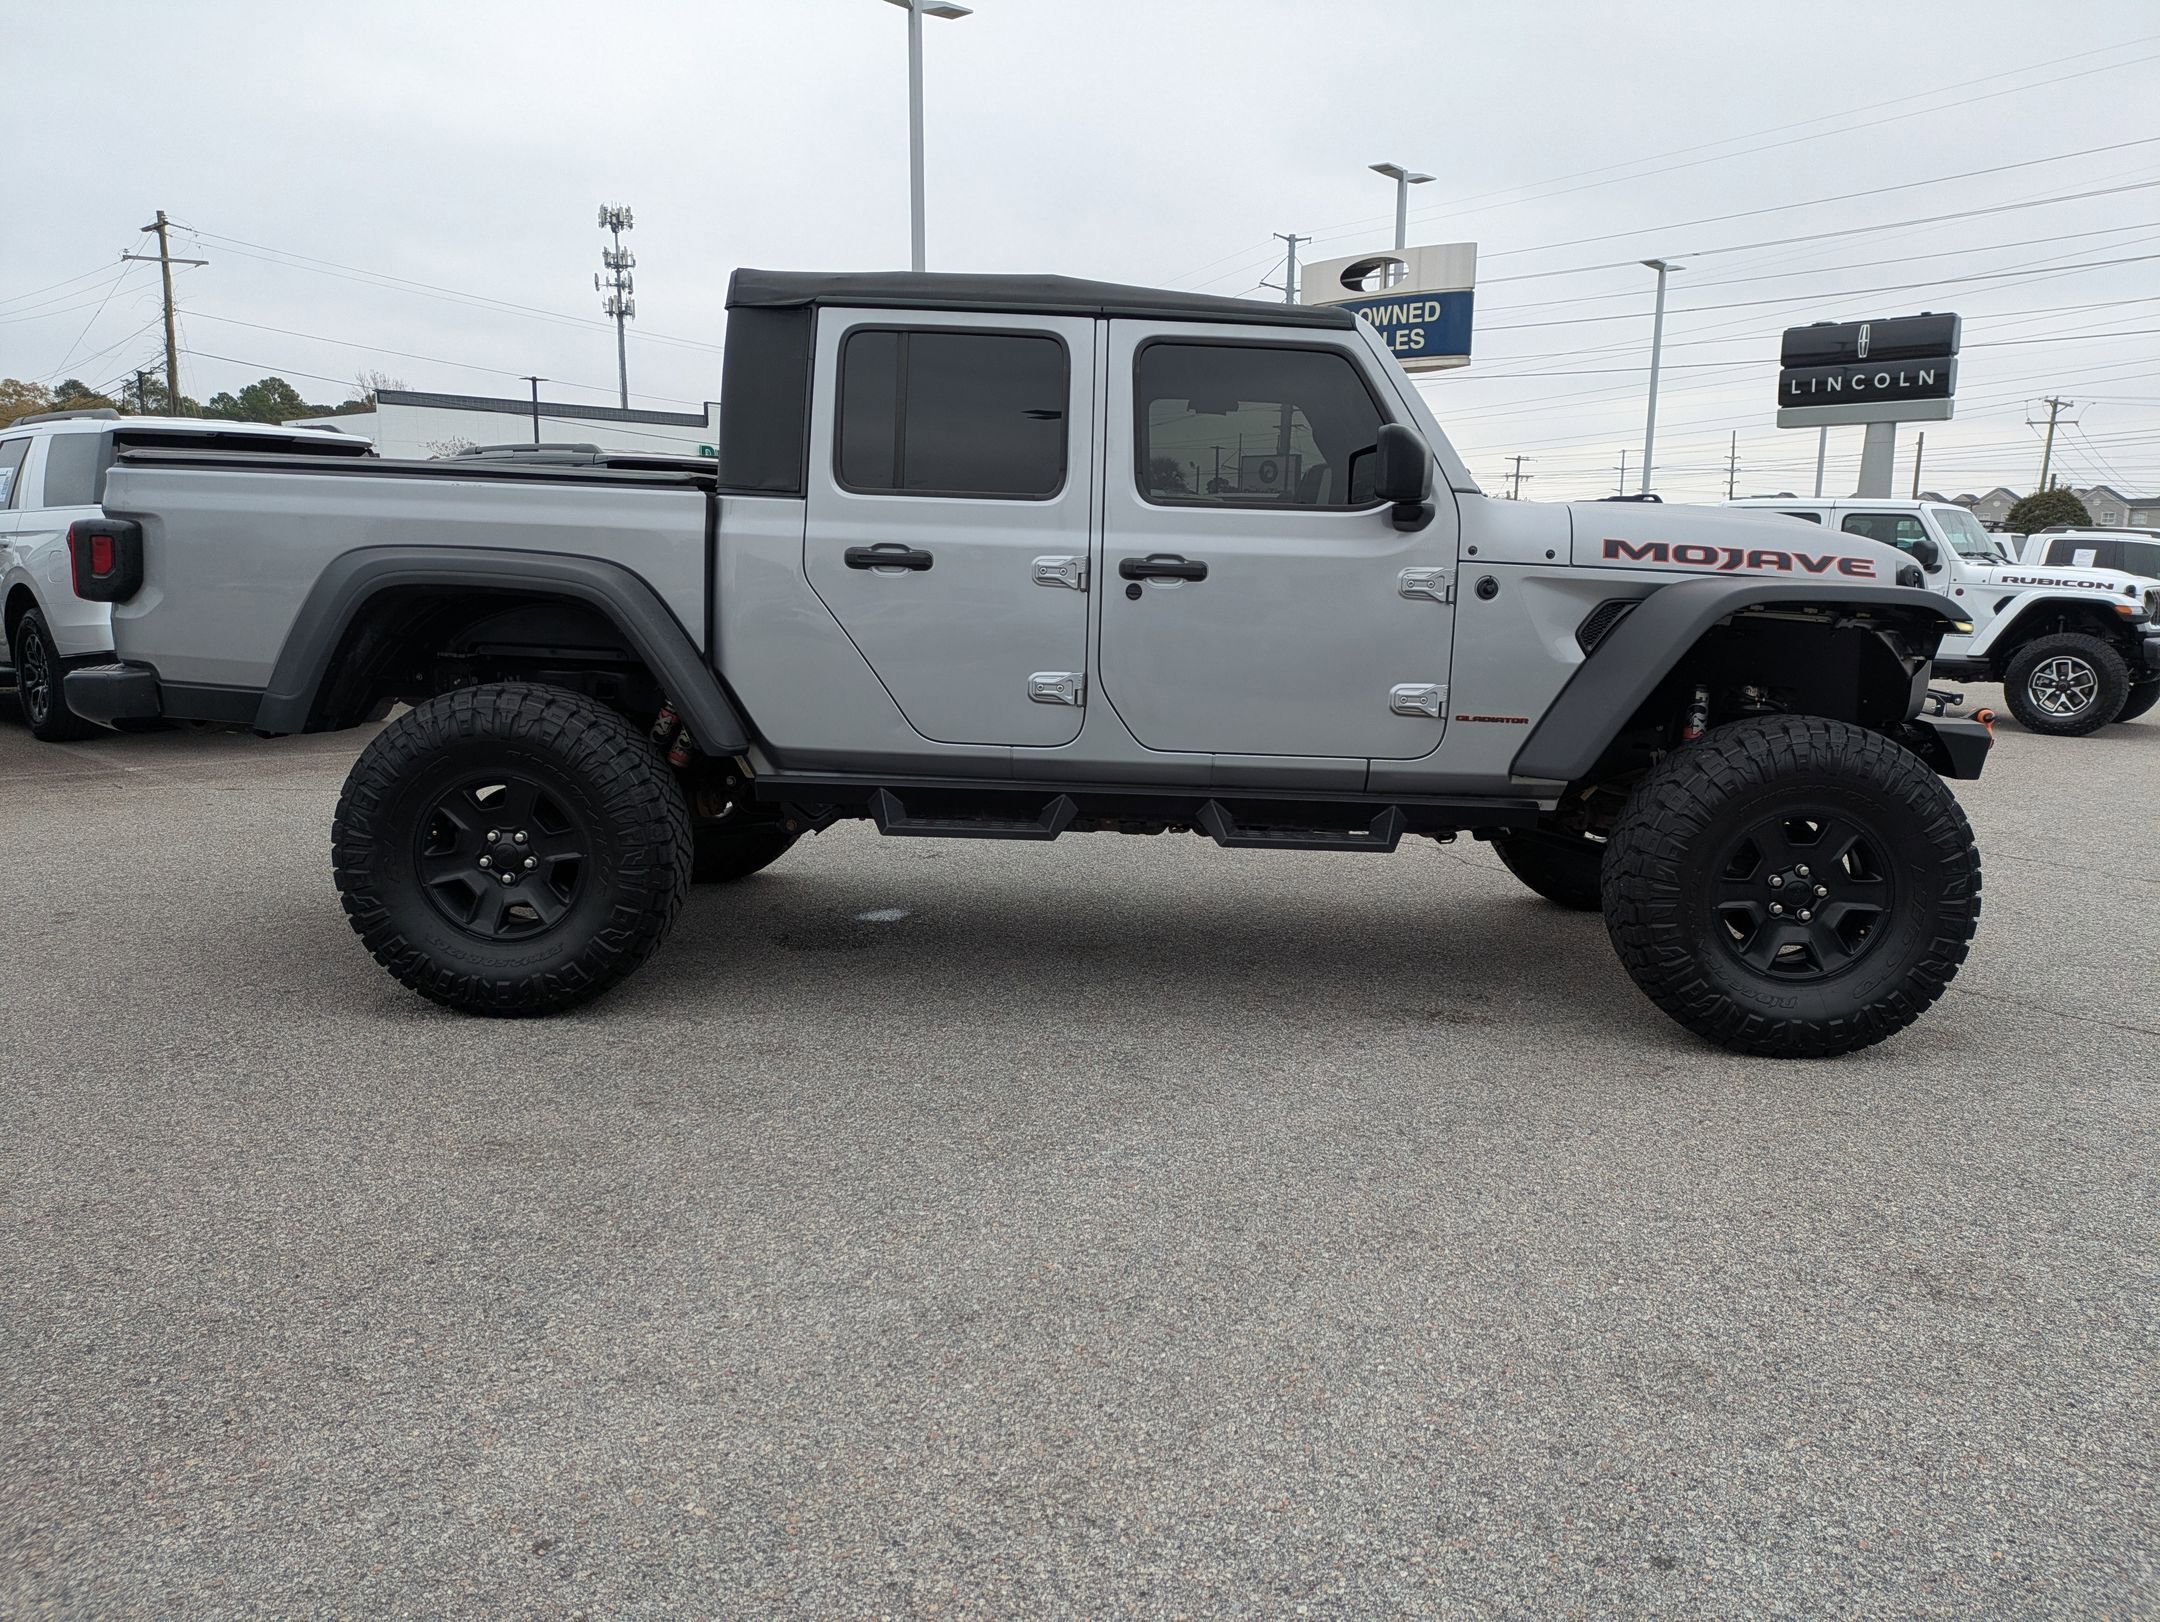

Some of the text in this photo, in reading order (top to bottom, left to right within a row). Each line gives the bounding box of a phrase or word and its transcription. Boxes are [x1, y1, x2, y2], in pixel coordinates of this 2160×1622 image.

[1791, 369, 1936, 394] LINCOLN
[1602, 538, 1877, 579] MOJAVE
[2001, 575, 2115, 590] RUBICON
[1455, 715, 1529, 724] GLADIATOR
